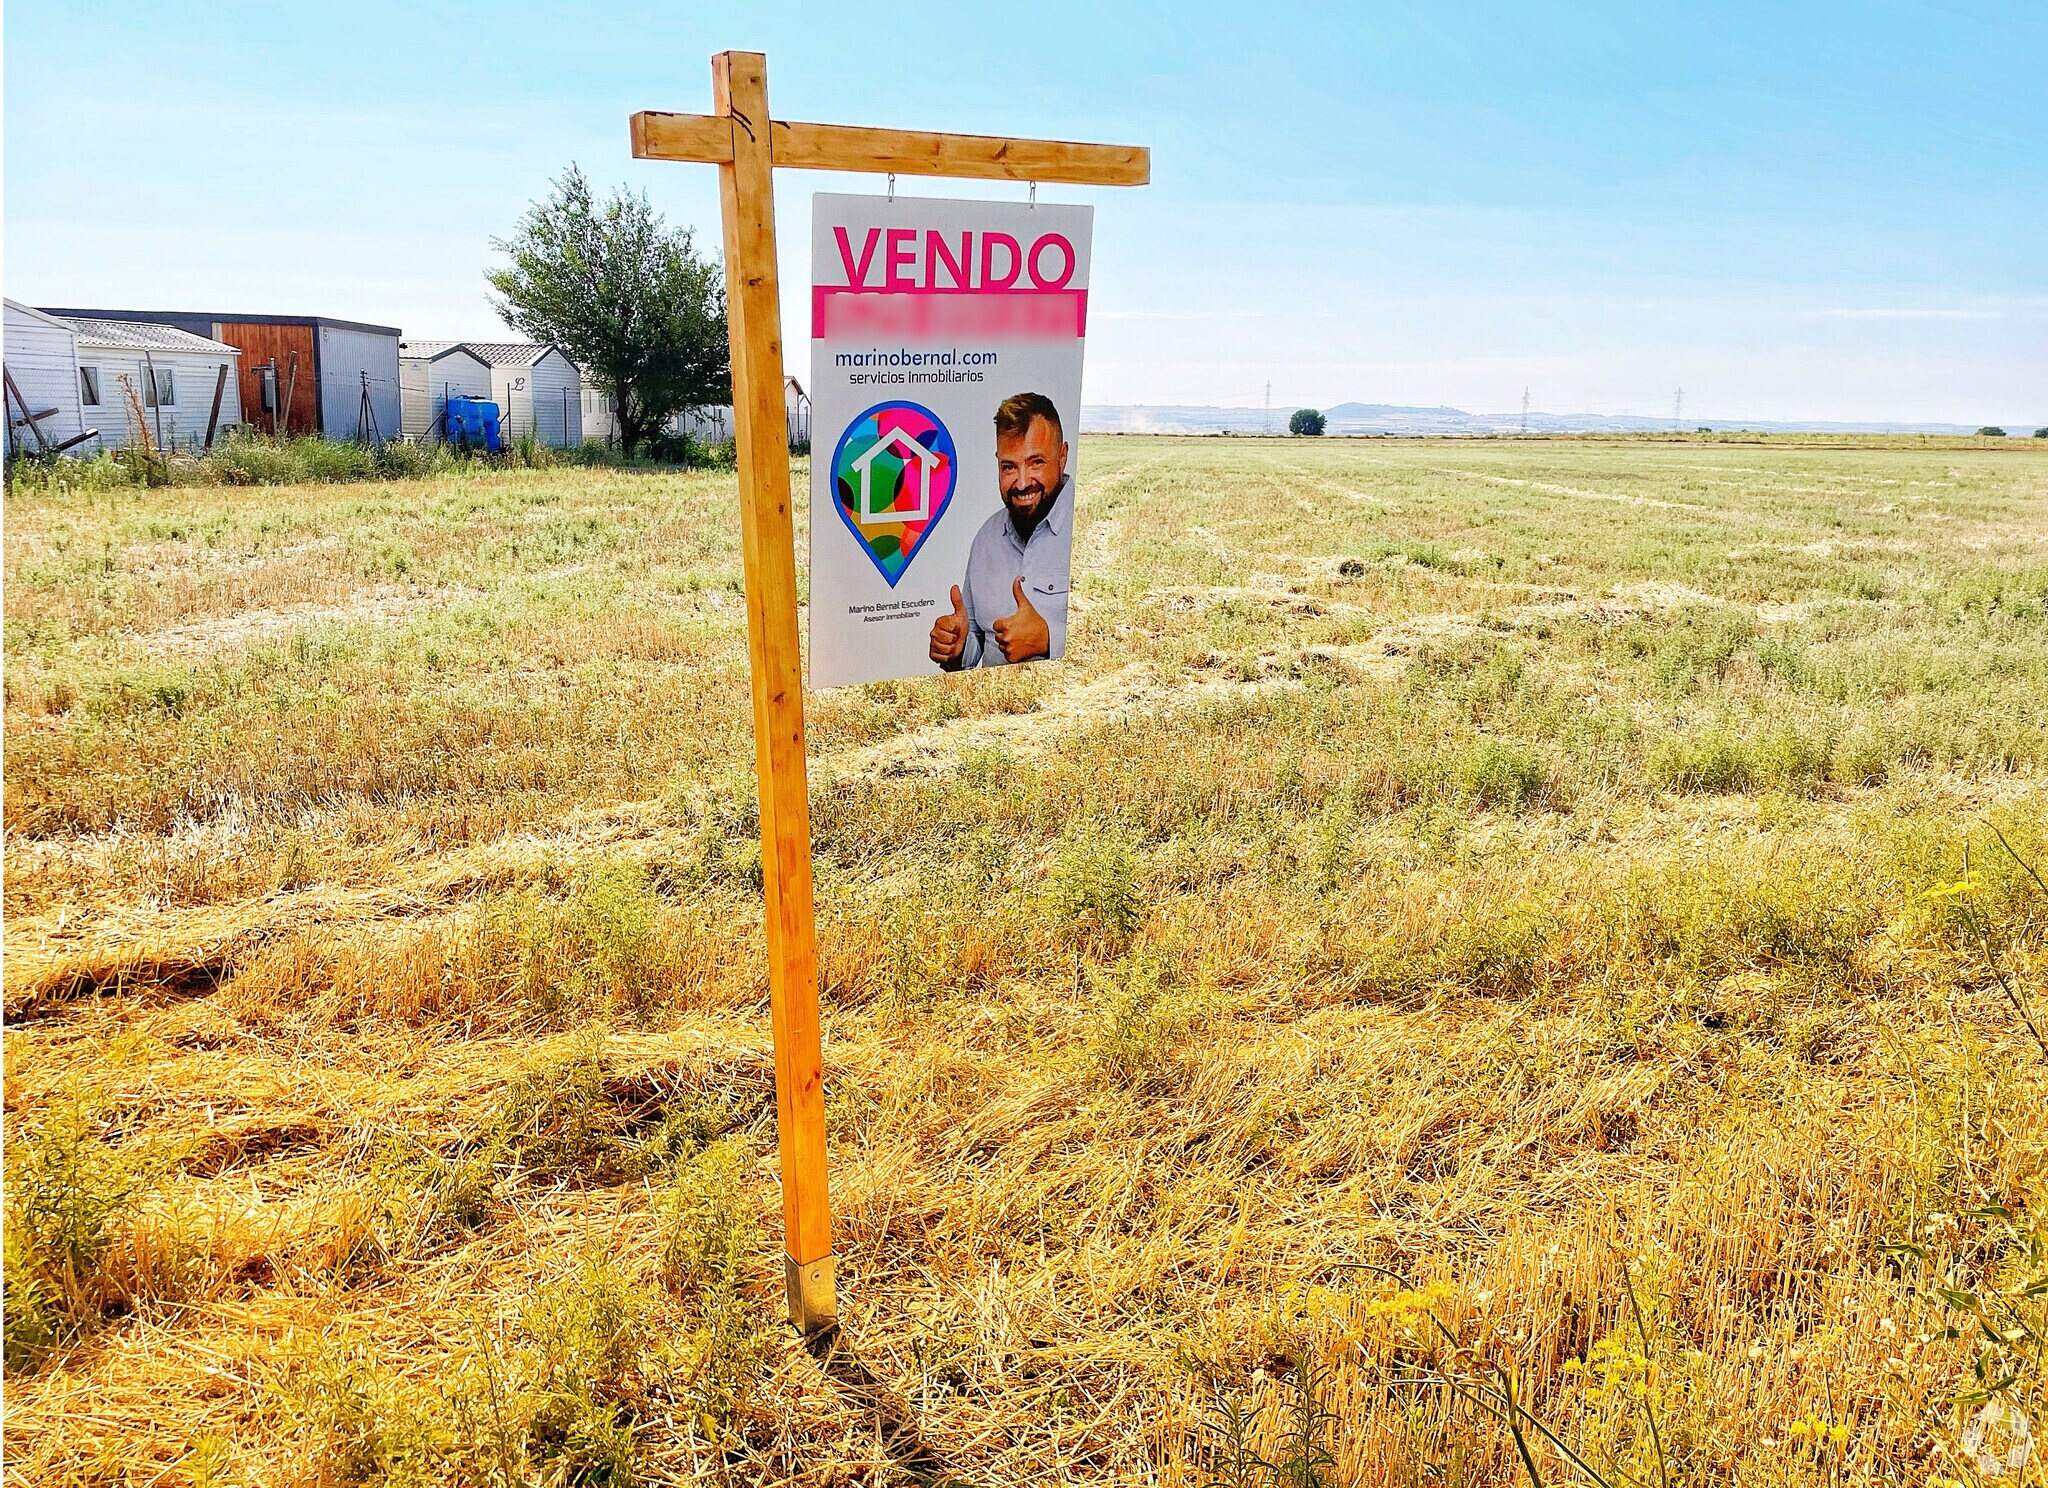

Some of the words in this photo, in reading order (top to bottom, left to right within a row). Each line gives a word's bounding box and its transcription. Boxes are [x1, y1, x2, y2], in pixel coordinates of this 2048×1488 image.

[833, 226, 1076, 291] VENDO
[835, 348, 997, 366] marinobernal.com
[850, 371, 904, 385] servicios
[908, 369, 984, 384] inmobiliarios
[849, 604, 875, 614] Marino
[876, 602, 900, 612] Bernal
[902, 598, 935, 609] Escudero
[863, 615, 885, 623] Asesor
